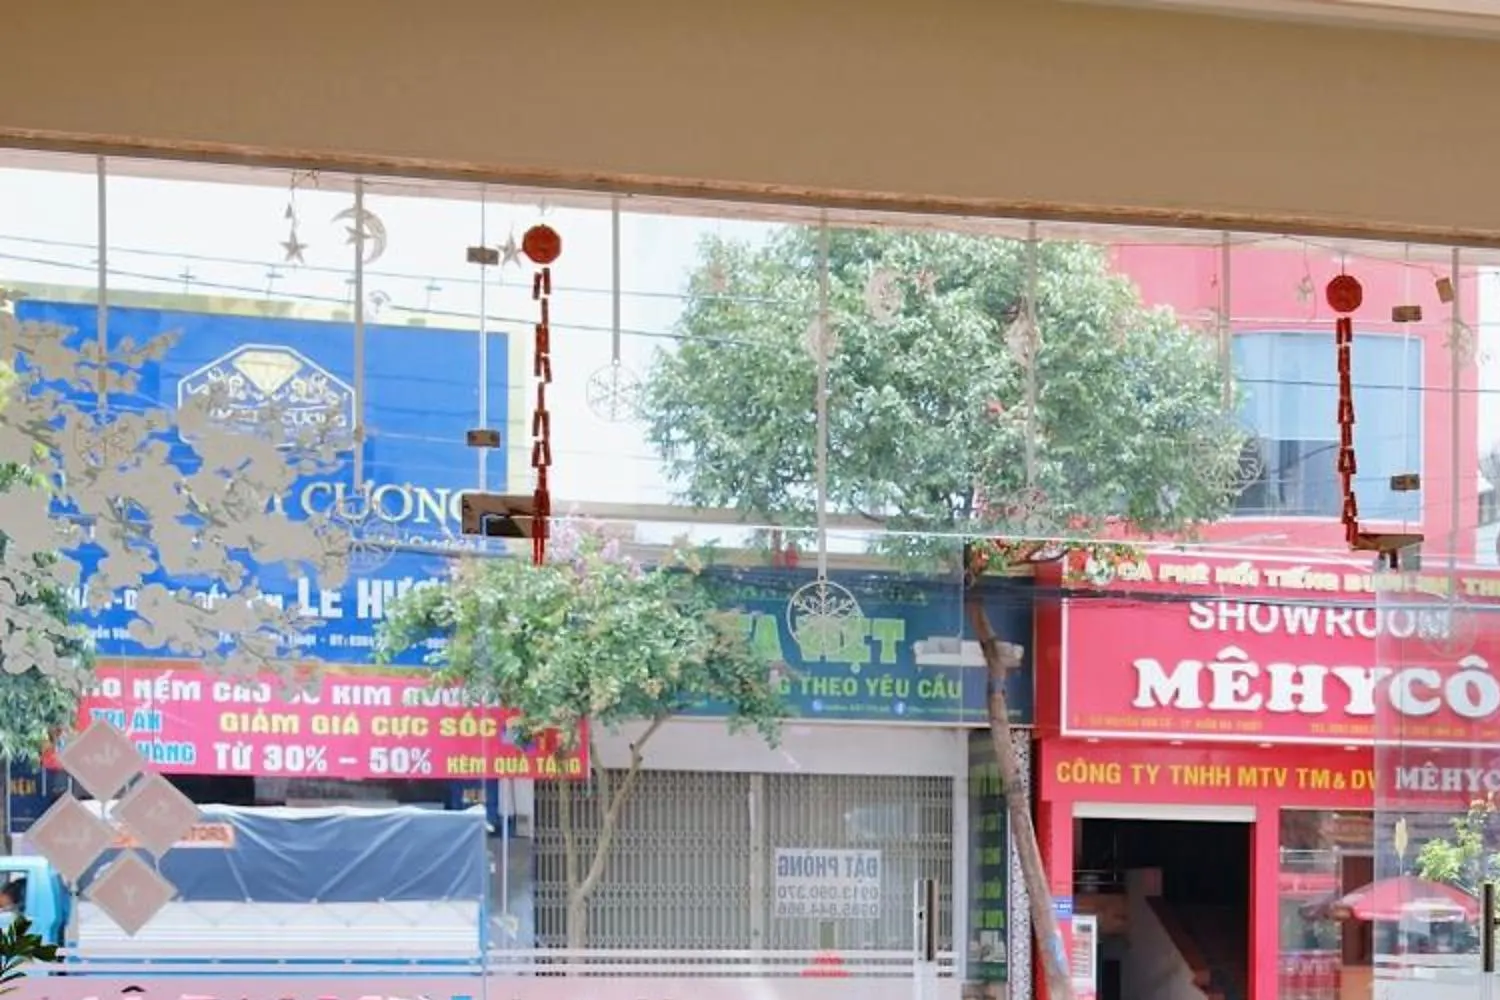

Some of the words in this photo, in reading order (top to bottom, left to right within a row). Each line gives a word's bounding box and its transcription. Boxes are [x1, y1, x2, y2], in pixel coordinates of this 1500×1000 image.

[1187, 600, 1452, 639] SHOWROOM
[331, 685, 392, 706] KIM
[800, 673, 858, 698] THEO
[865, 673, 910, 699] YÊU
[219, 709, 301, 735] GIẢM
[311, 713, 361, 737] GIÁ
[262, 744, 328, 773] 30%
[368, 747, 432, 775] 50%
[1056, 757, 1122, 784] CÔNG
[1130, 763, 1161, 786] TY
[1169, 764, 1231, 786] TNHH
[1237, 766, 1288, 788] MTV
